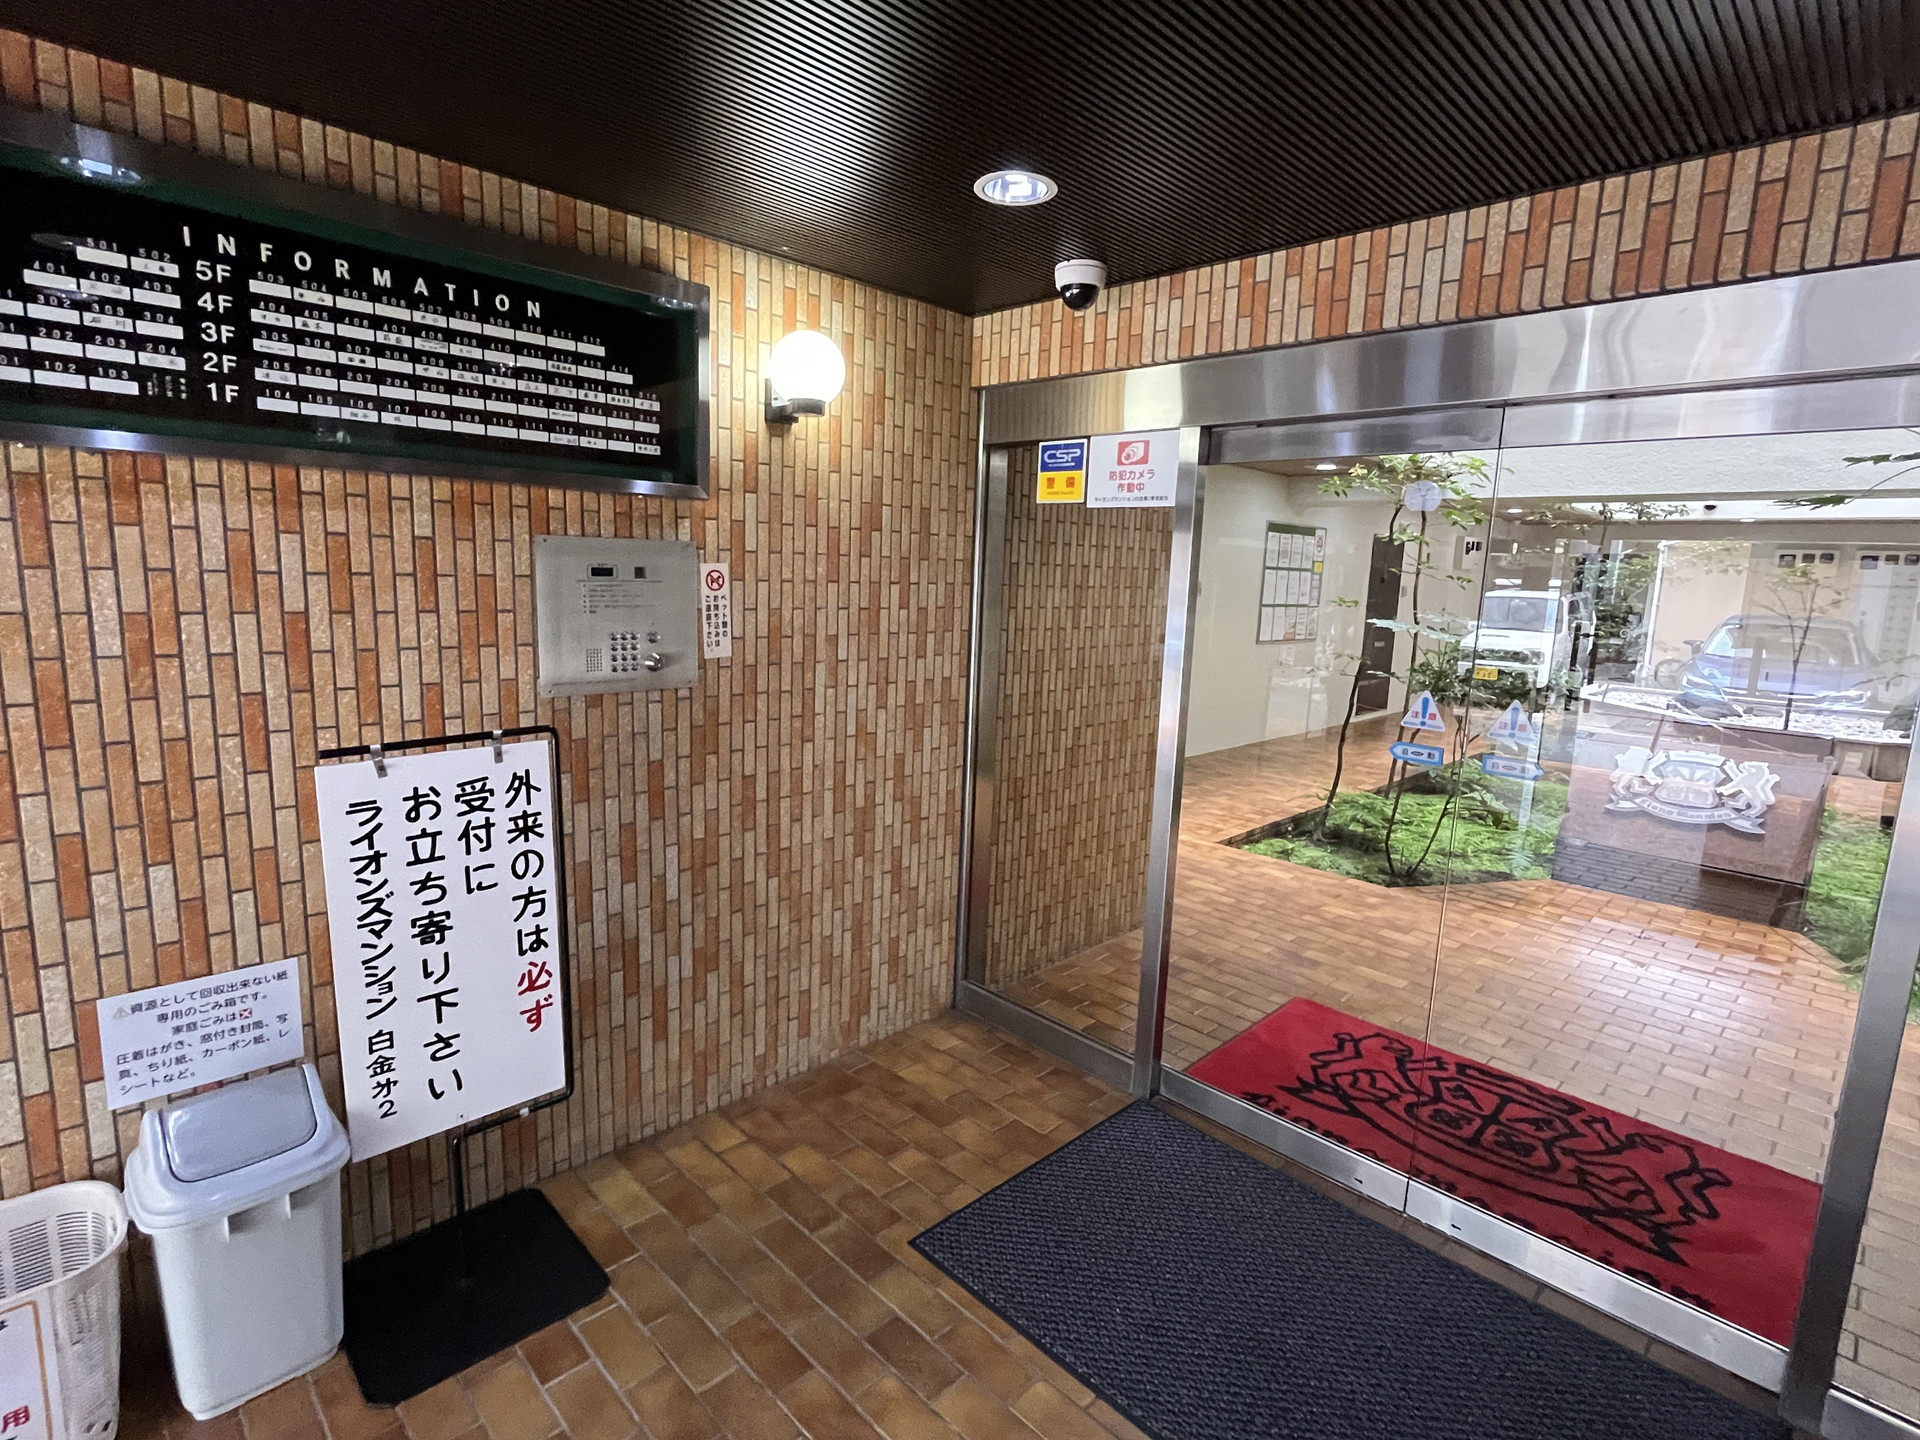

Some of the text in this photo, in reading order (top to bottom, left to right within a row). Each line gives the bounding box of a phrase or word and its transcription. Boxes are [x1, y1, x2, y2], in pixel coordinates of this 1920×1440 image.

[33, 260, 65, 274] 401
[89, 271, 121, 284] 402
[143, 280, 172, 293] 403
[197, 291, 233, 314] 4F
[259, 301, 285, 314] 404
[304, 309, 328, 320] 405
[344, 317, 368, 328] 406
[383, 323, 406, 334] 407
[421, 330, 443, 340] 408
[456, 336, 477, 347] 409
[490, 343, 510, 352] 410
[87, 237, 117, 252] 501
[139, 247, 171, 262] 502
[196, 259, 232, 284] 5F
[257, 271, 284, 284] 503
[301, 280, 327, 293] 504
[343, 288, 368, 300] 505
[382, 296, 406, 308] 506
[420, 303, 442, 314] 507
[455, 310, 477, 321] 508
[490, 317, 510, 328] 509
[182, 225, 541, 320] INFORMATION
[37, 294, 71, 308] 302
[92, 303, 124, 316] 303
[143, 311, 174, 324] 304
[201, 321, 236, 344] 3F
[261, 330, 288, 343] 305
[305, 337, 330, 349] 306
[346, 344, 371, 355] 307
[385, 350, 408, 361] 308
[422, 356, 444, 367] 309
[458, 361, 479, 372] 310
[491, 367, 512, 377] 311
[38, 327, 73, 341] 202
[95, 335, 126, 349] 203
[146, 343, 177, 356] 204
[203, 351, 238, 374] 2F
[262, 360, 291, 372] 205
[305, 366, 331, 377] 206
[347, 371, 371, 382] 207
[386, 377, 409, 388] 208
[422, 382, 445, 393] 209
[458, 388, 479, 398] 210
[491, 392, 512, 402] 211
[0, 354, 19, 366] 01
[44, 360, 76, 373] 102
[98, 367, 129, 380] 103
[206, 381, 240, 403] 1F
[266, 388, 290, 400] 104
[308, 394, 333, 405] 105
[350, 399, 374, 410] 106
[388, 404, 410, 414] 107
[424, 408, 446, 419] 108
[460, 413, 480, 423] 109
[493, 417, 513, 427] 110
[1043, 448, 1081, 463] CSP
[1108, 469, 1155, 481] 防犯カメラ
[1117, 482, 1145, 493] 作動中
[720, 594, 728, 638] ペット類の
[455, 775, 499, 895] 受付に
[345, 800, 398, 1021] ライオンズマンション
[402, 785, 464, 1101] お立ち寄り下さい
[130, 970, 289, 1015] 資源として回収出来ない紙
[157, 992, 268, 1024] 専用のごみ箱です。
[171, 1012, 237, 1036] 家庭ごみは
[119, 1068, 197, 1096] シートなど。
